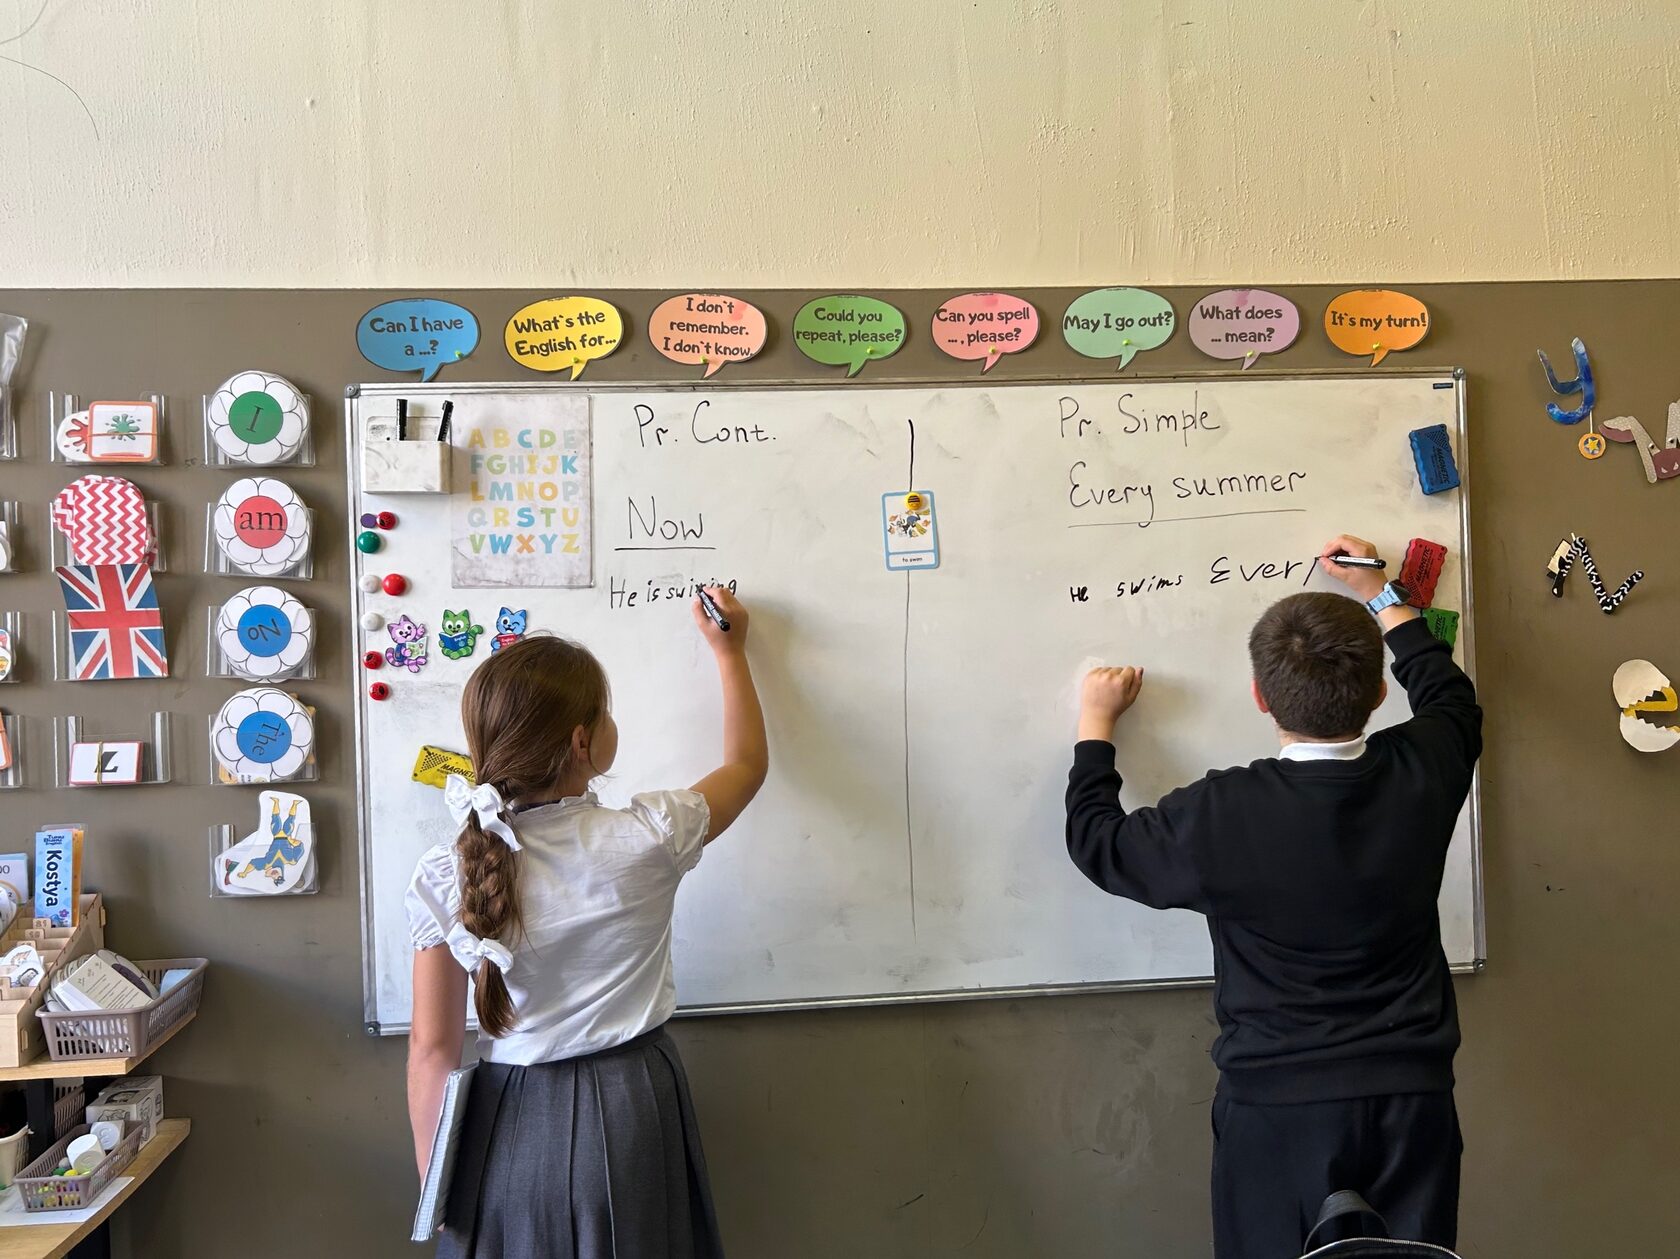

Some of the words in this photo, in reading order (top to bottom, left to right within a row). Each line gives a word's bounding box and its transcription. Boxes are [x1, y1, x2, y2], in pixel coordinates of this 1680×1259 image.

[686, 297, 694, 312] I
[1200, 305, 1242, 320] What
[1245, 305, 1283, 320] does
[370, 317, 407, 333] Can
[410, 316, 419, 332] I
[422, 316, 464, 332] have
[577, 311, 605, 327] the
[814, 307, 854, 322] Could
[858, 311, 883, 325] you
[935, 308, 965, 323] Can
[968, 311, 994, 325] you
[997, 307, 1030, 322] spell
[1064, 315, 1100, 333] May
[1103, 313, 1112, 329] I
[1115, 317, 1134, 332] go
[1138, 311, 1173, 327] out?
[1360, 317, 1382, 331] my
[1386, 312, 1427, 328] turn!
[669, 320, 750, 336] remember.
[796, 329, 846, 344] repeat,
[849, 328, 902, 346] please?
[967, 328, 1022, 346] please?
[1225, 328, 1275, 343] mean?
[404, 344, 414, 356] a
[515, 339, 577, 358] English
[663, 337, 671, 351] I
[714, 342, 754, 357] know.
[634, 403, 679, 447] Pr.
[692, 400, 777, 444] Cont.
[1058, 396, 1102, 438] Pr.
[1118, 390, 1221, 447] Simple
[1069, 461, 1155, 528] Every
[1173, 471, 1307, 499] summer
[239, 511, 286, 531] am
[628, 496, 704, 540] Now
[610, 576, 638, 609] He
[647, 580, 660, 602] is
[1070, 586, 1089, 602] He
[1117, 575, 1183, 597] swims
[441, 763, 475, 778] MAGNET
[42, 850, 62, 907] Kostya
